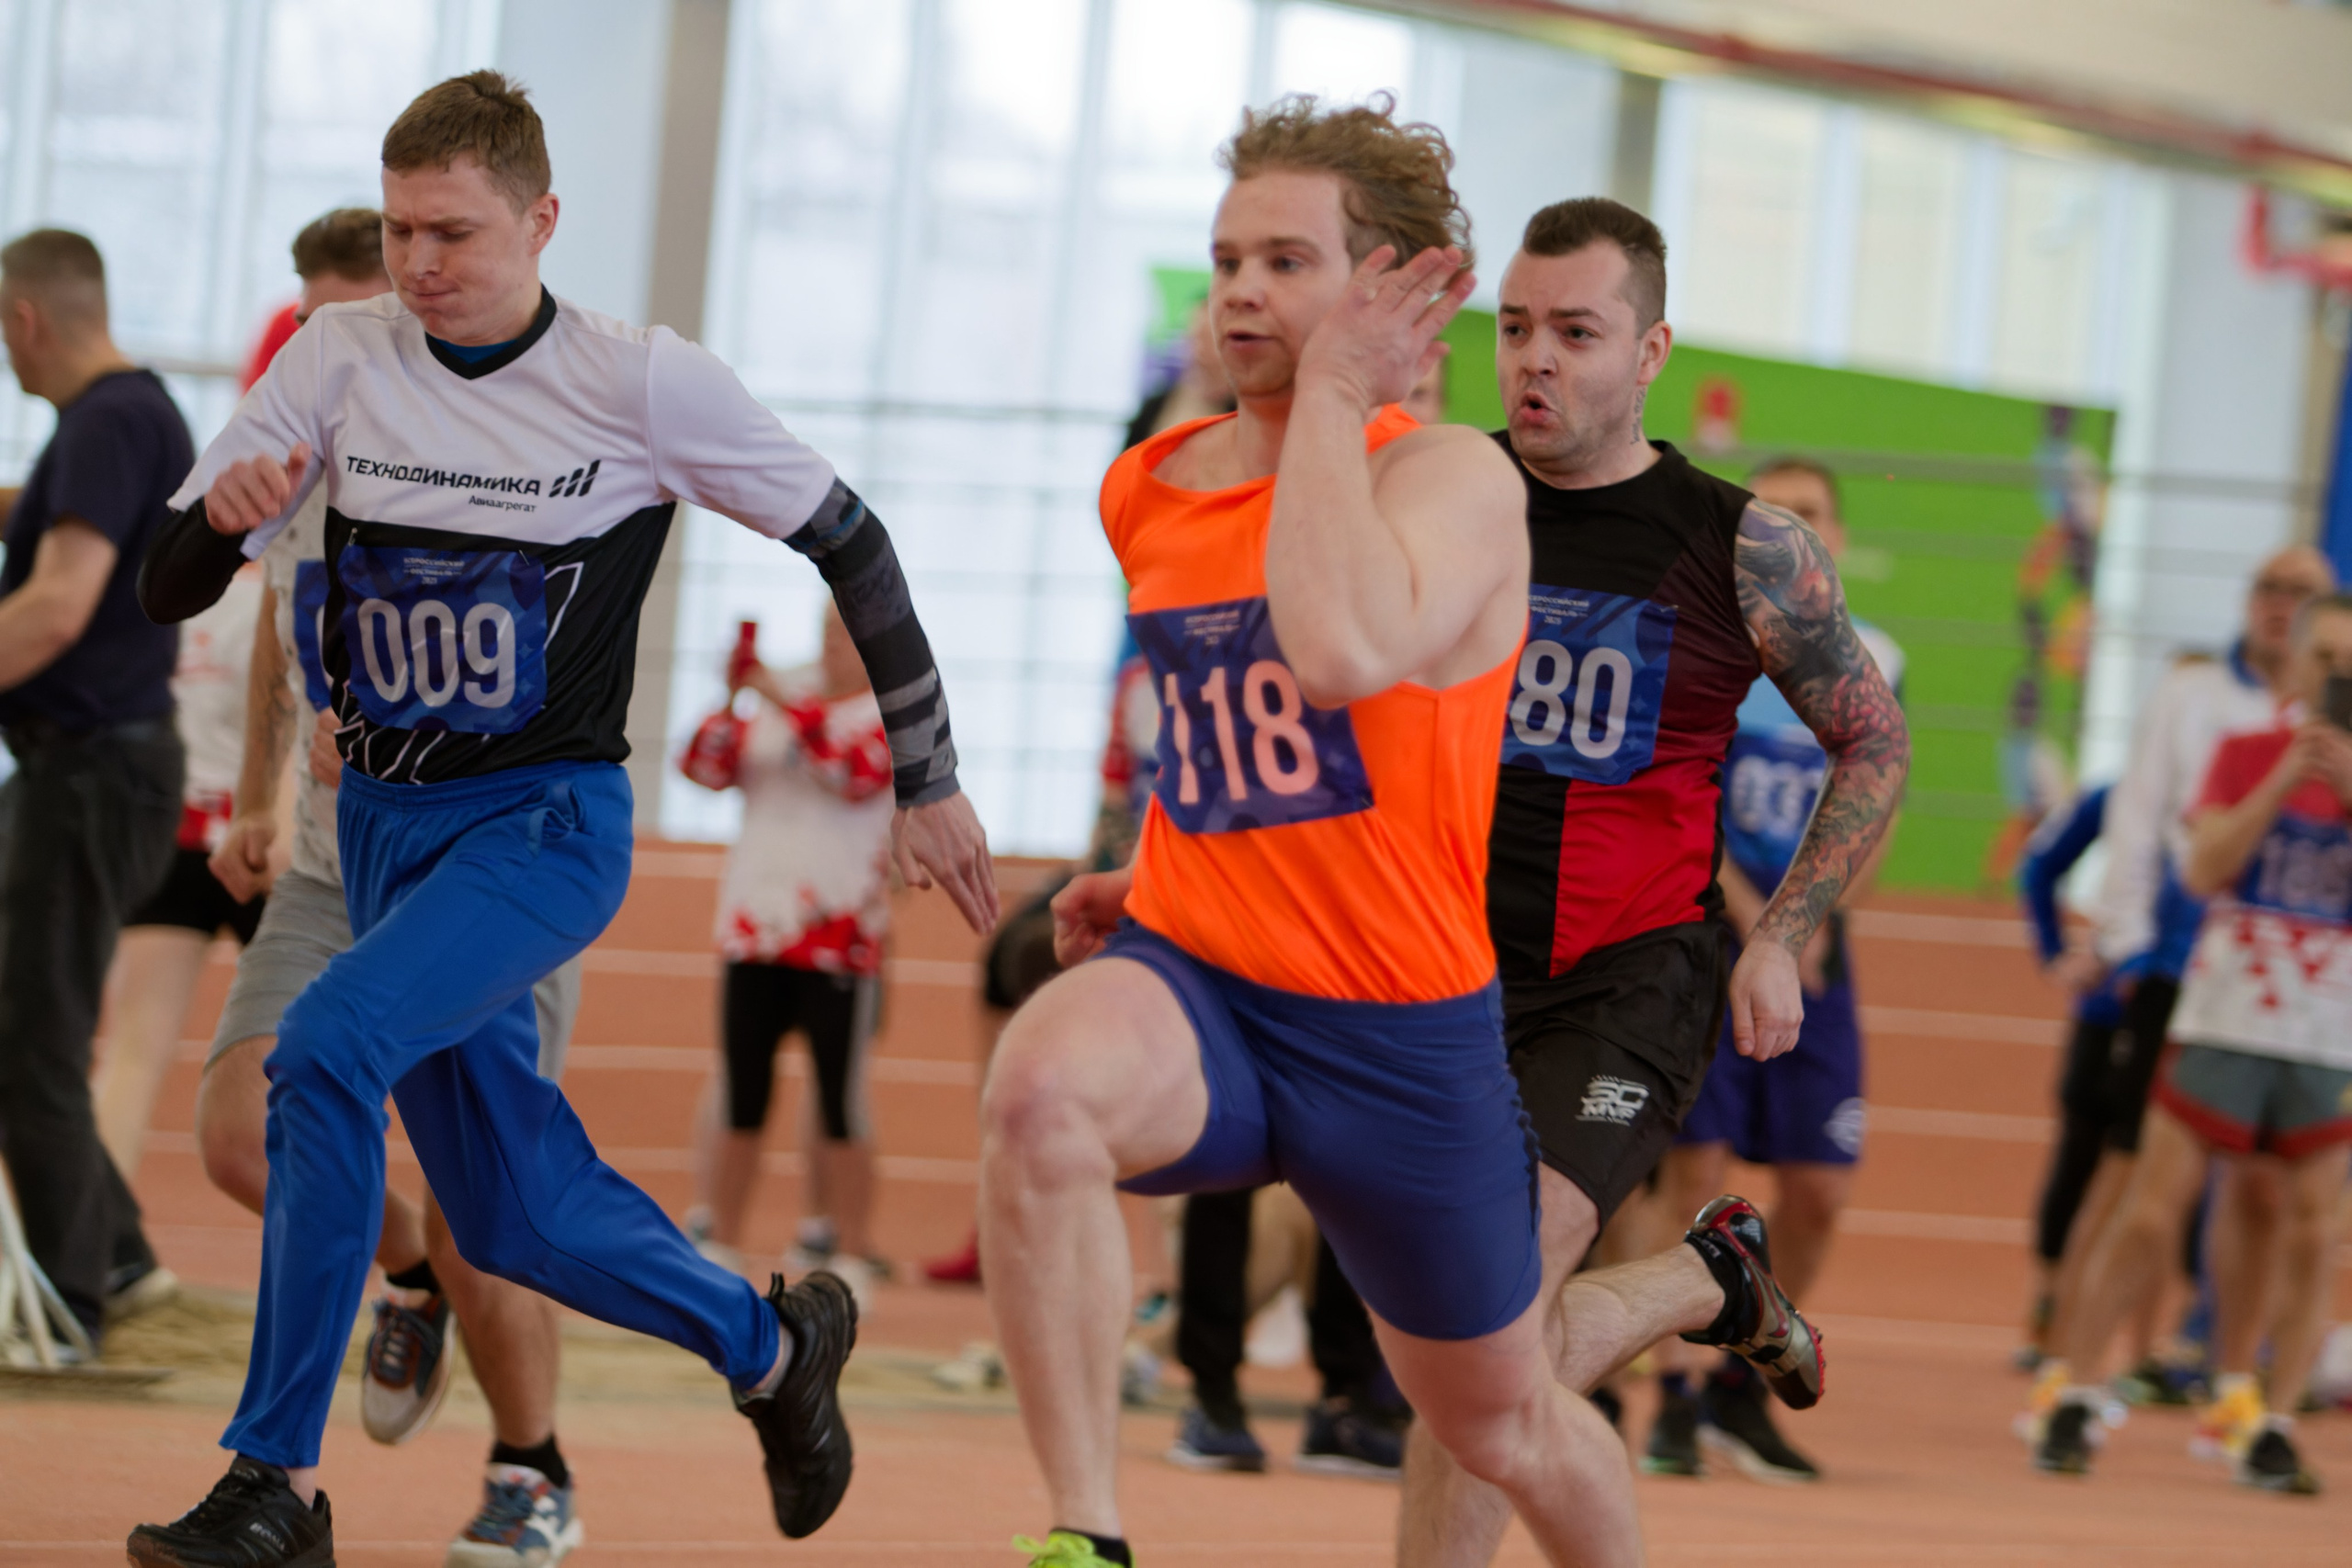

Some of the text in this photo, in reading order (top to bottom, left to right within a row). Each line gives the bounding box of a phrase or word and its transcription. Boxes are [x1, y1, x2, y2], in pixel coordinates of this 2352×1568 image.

[347, 456, 540, 496] ТЕХНОДИНАМИКА
[469, 495, 537, 513] Авиаагрегат
[357, 598, 515, 708] 009
[1510, 639, 1632, 759] 80
[1164, 660, 1320, 806] 118
